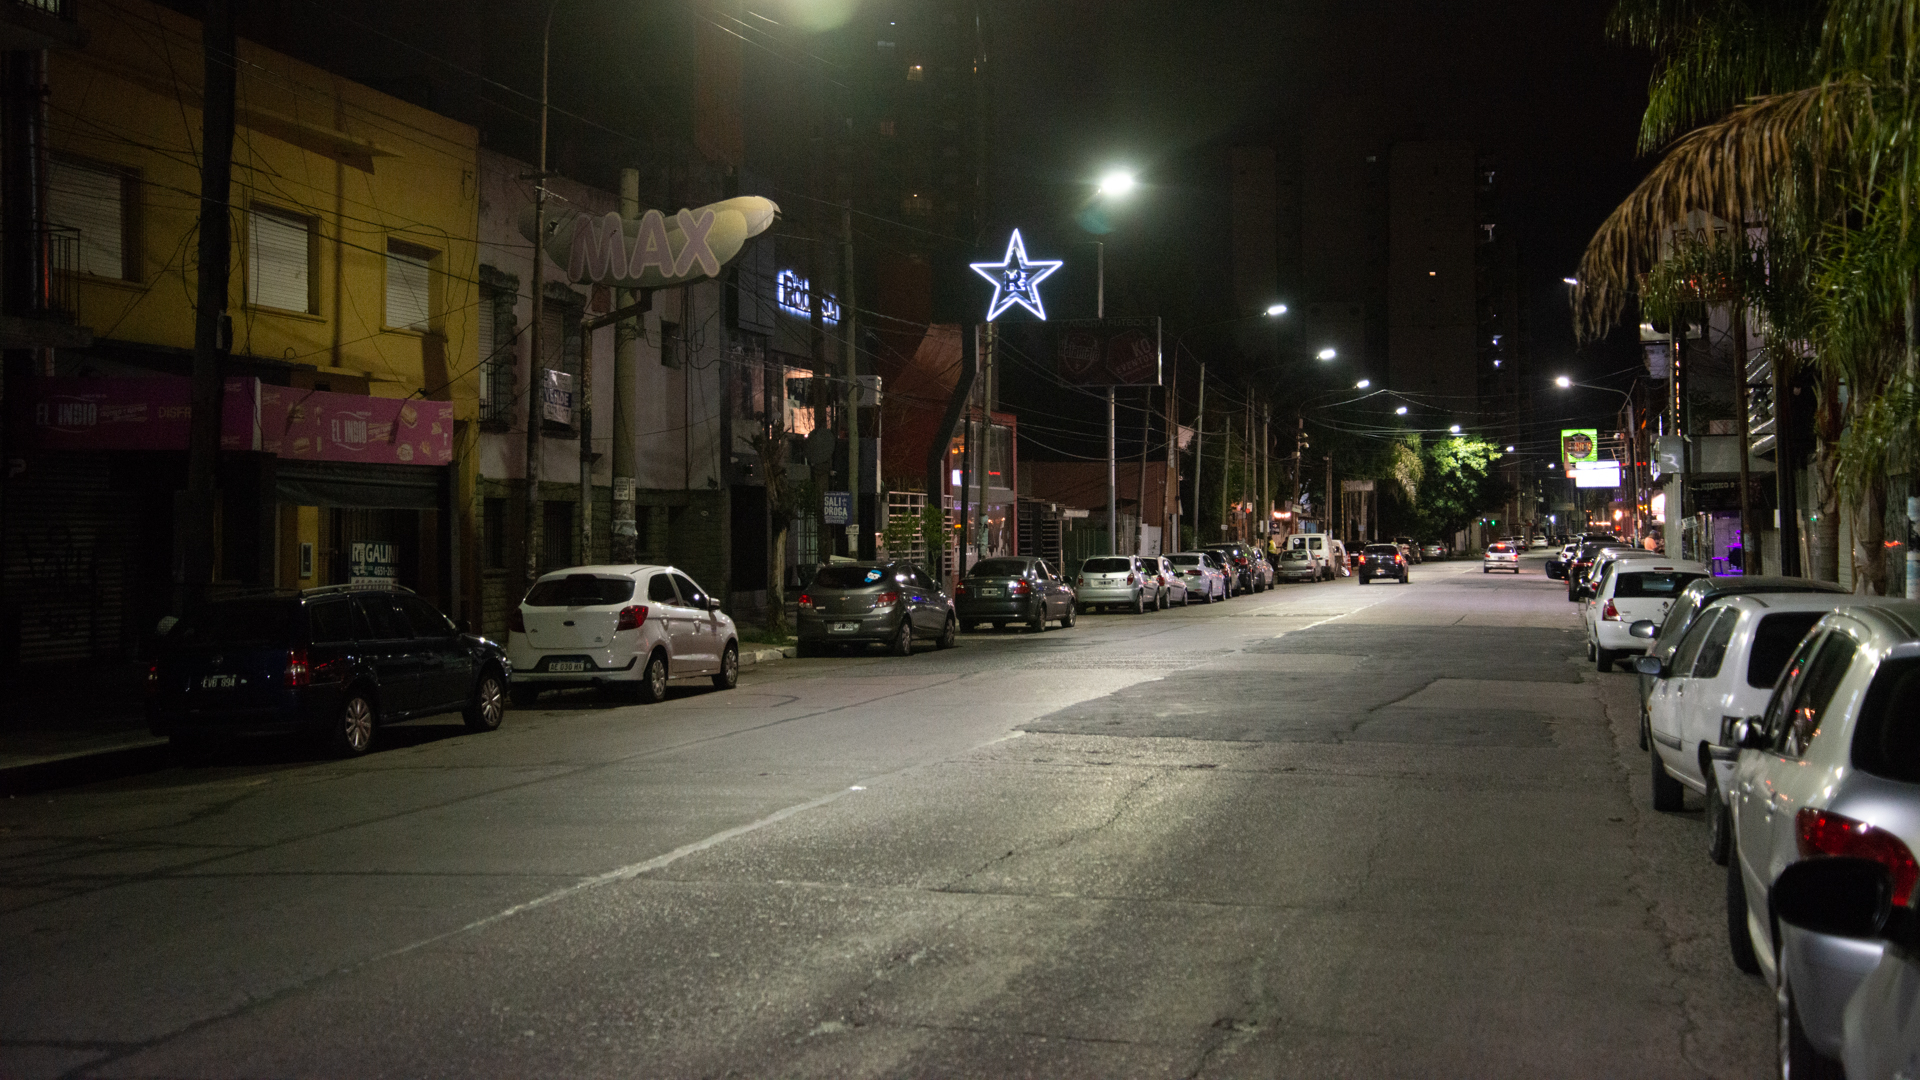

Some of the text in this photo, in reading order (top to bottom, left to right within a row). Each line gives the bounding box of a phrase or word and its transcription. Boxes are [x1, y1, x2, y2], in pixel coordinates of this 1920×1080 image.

[567, 207, 721, 283] MAX
[1131, 338, 1151, 357] KO
[1116, 352, 1155, 374] EVENTOS
[35, 402, 50, 426] EL
[57, 402, 98, 426] INDIO
[331, 419, 342, 443] EL
[344, 420, 368, 444] INDIO
[824, 496, 841, 506] SALI
[824, 507, 848, 516] DROGA
